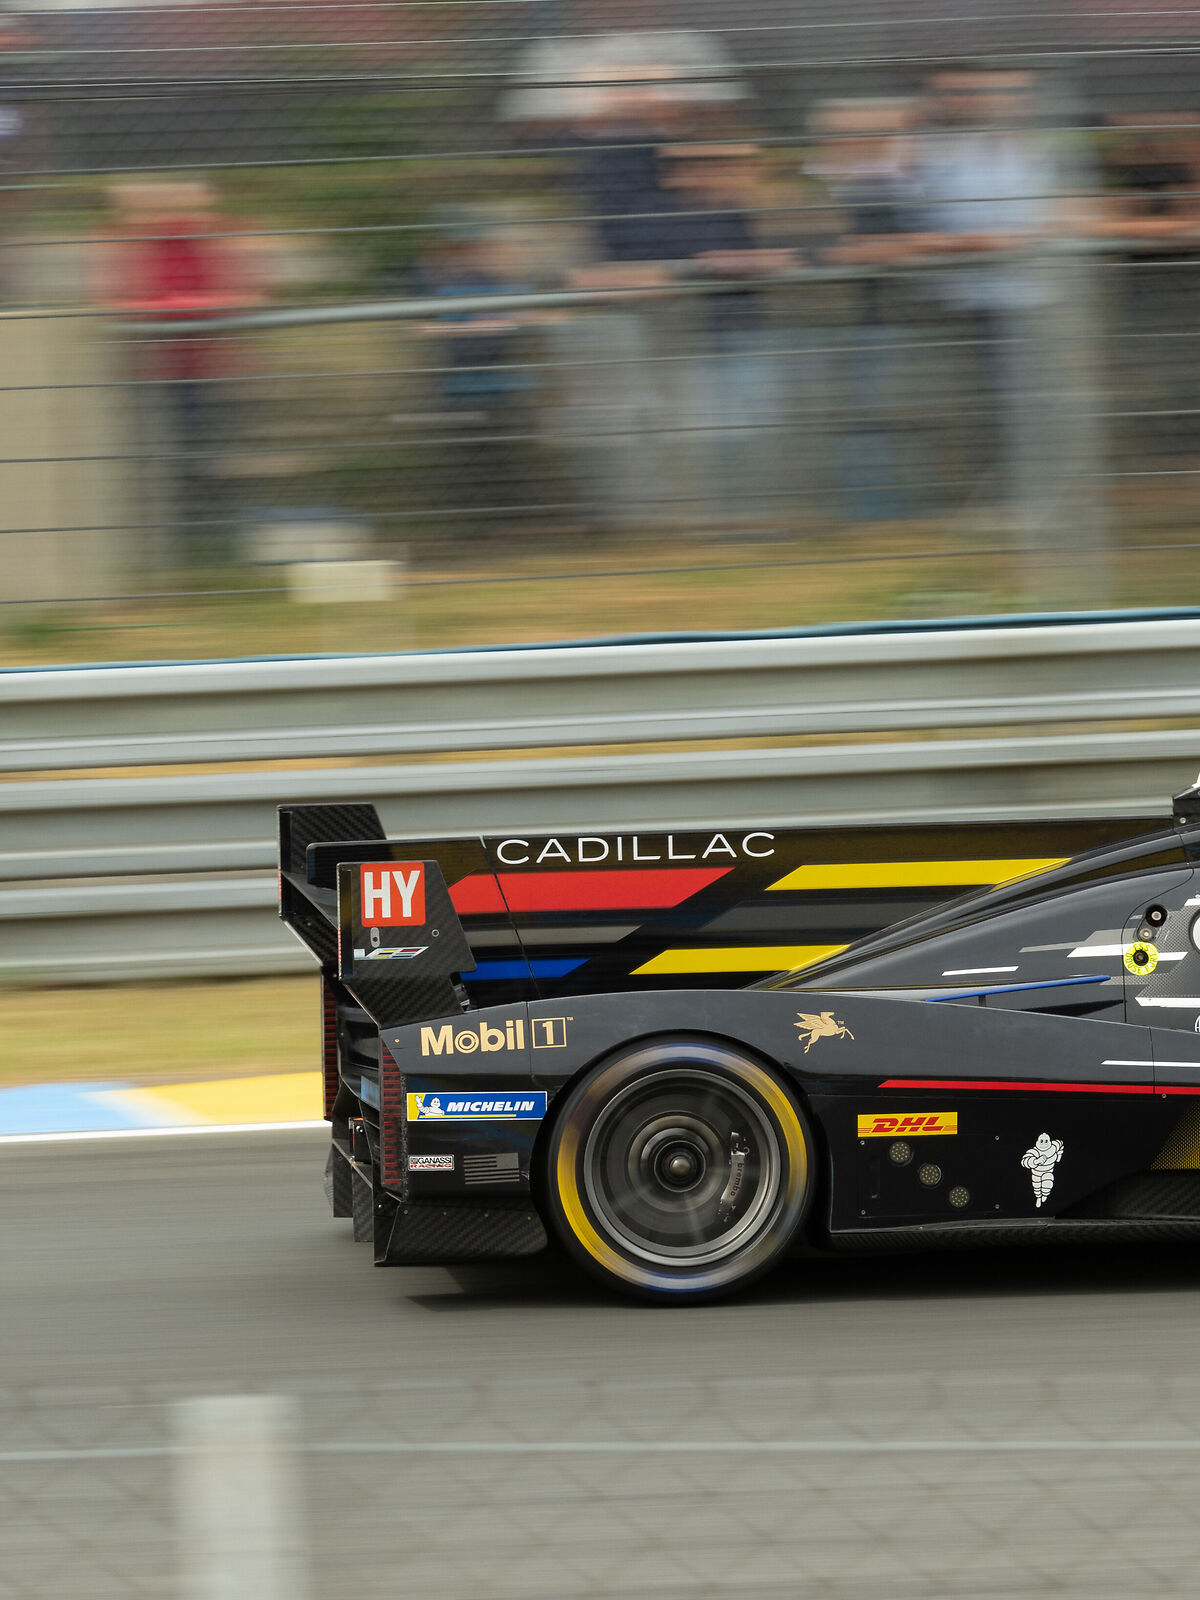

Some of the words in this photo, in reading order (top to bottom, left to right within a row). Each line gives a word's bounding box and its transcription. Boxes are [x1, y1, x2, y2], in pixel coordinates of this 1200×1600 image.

[496, 832, 776, 865] CADILLAC
[364, 870, 420, 918] HY
[420, 1019, 526, 1057] Mobil
[446, 1101, 535, 1112] MICHELIN
[871, 1116, 944, 1133] DHL
[730, 1162, 745, 1197] brembo
